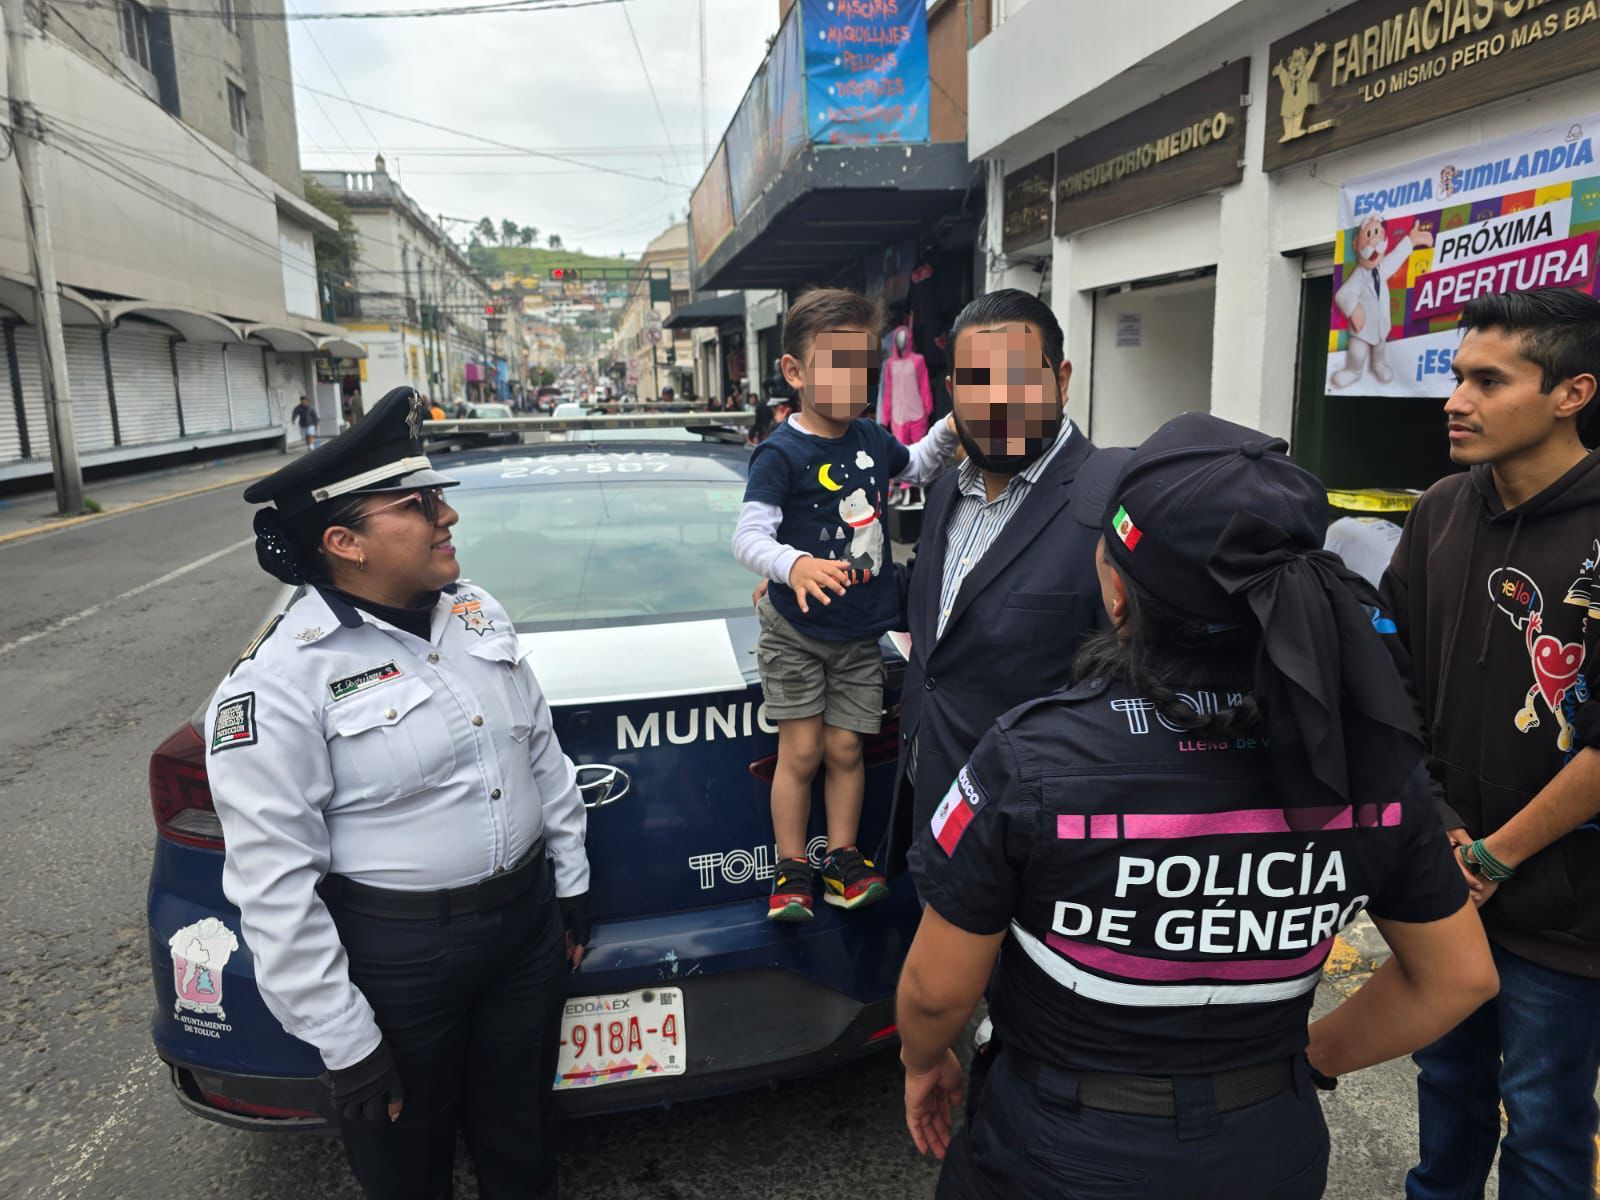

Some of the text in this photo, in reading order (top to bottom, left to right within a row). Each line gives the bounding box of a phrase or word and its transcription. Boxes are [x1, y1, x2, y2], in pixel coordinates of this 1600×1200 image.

[1331, 0, 1494, 88] FARMACIAS
[1390, 55, 1447, 91] MISMO
[1451, 40, 1504, 70] PERO
[1510, 13, 1559, 49] MAS
[1563, 0, 1600, 31] BA
[1058, 111, 1227, 201] CONSULTORIO MEDICO
[1440, 211, 1553, 263] PRÓXIMA
[1415, 244, 1589, 312] APERTURA
[1416, 348, 1457, 382] ¡ES
[1114, 841, 1347, 899] POLICÍA
[1051, 894, 1371, 954] DE GÉNERO
[180, 1015, 233, 1032] AYUNTAMIENTO
[194, 1026, 221, 1039] TOLUCA
